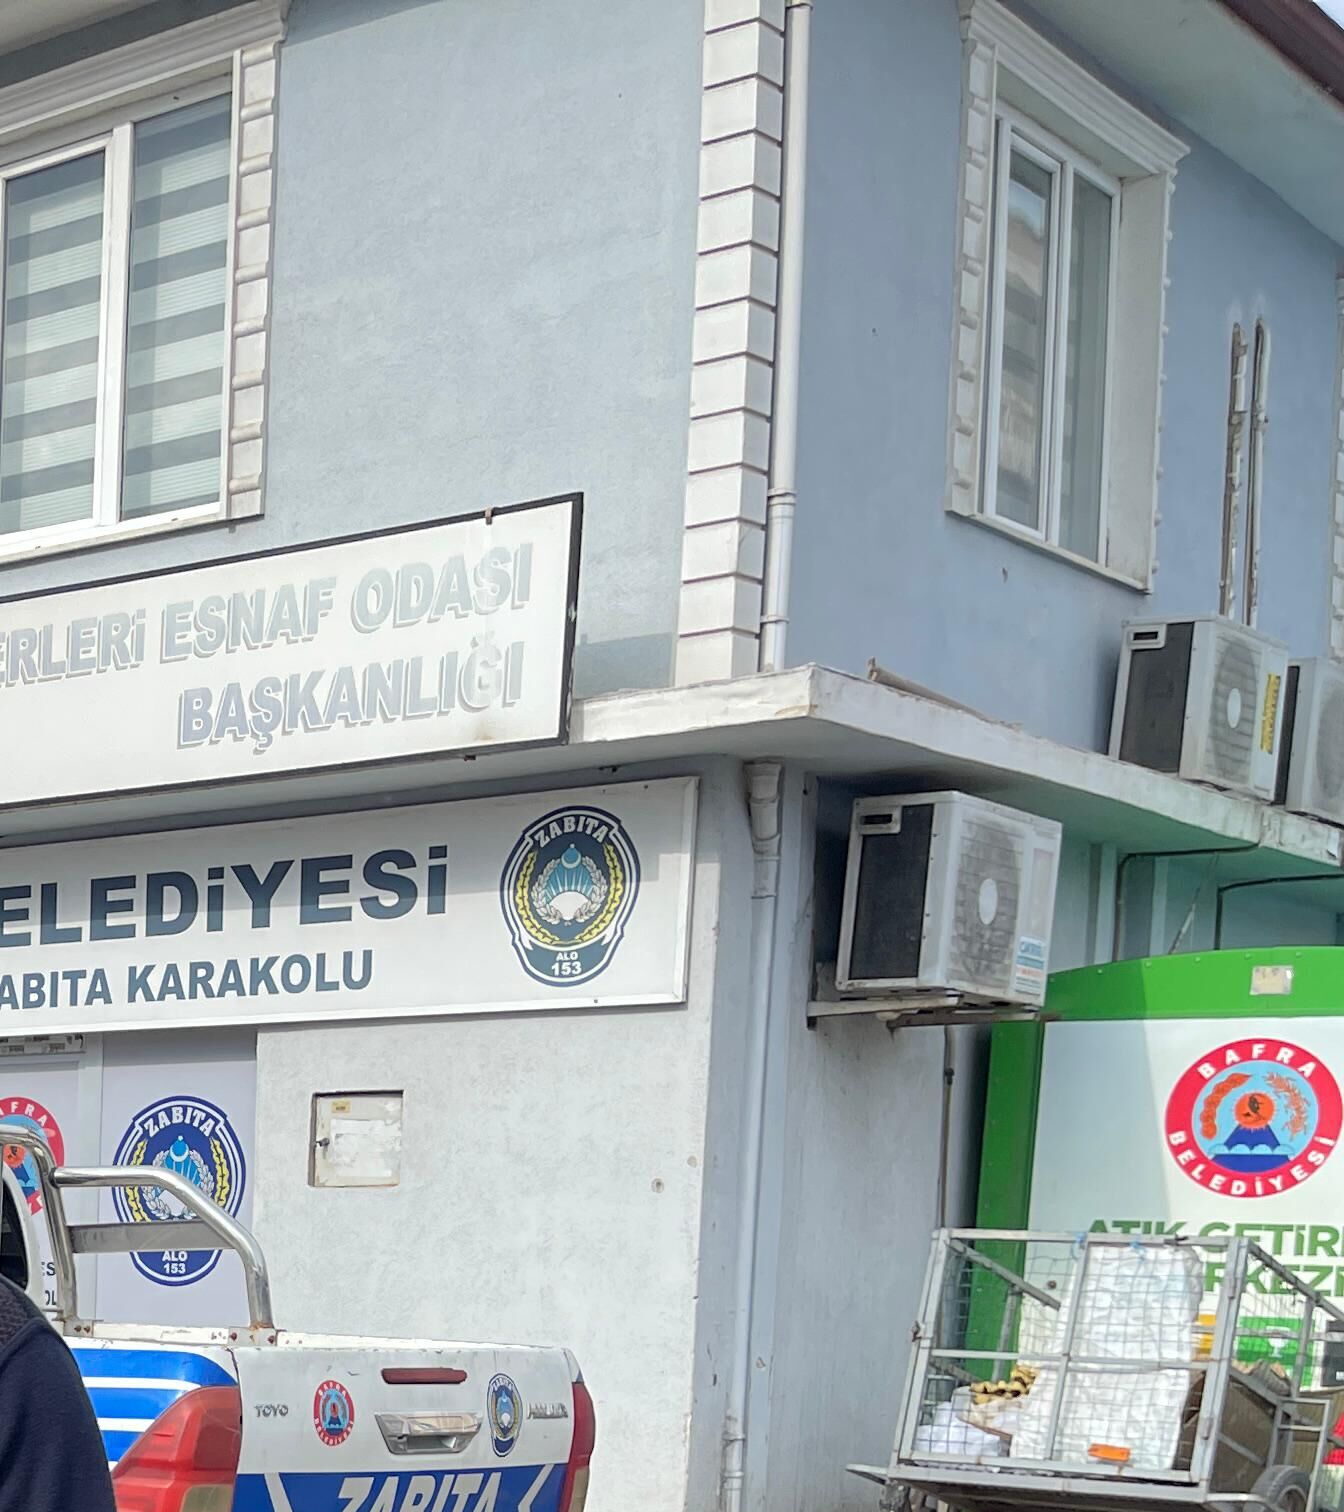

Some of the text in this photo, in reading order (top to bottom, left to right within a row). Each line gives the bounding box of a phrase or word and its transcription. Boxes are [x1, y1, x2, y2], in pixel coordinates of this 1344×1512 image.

[160, 576, 338, 664] ESNAF
[350, 542, 534, 634] ODASI
[176, 630, 525, 755] BAŞKANLIĞI
[534, 816, 609, 848] ZABITA
[551, 961, 582, 976] 153
[556, 951, 579, 961] ALO
[128, 949, 374, 1002] KARAKOLU
[1196, 1043, 1315, 1080] BAFRA
[144, 1106, 216, 1138] ZABITA
[162, 1251, 188, 1262] ALO
[164, 1262, 186, 1274] 153
